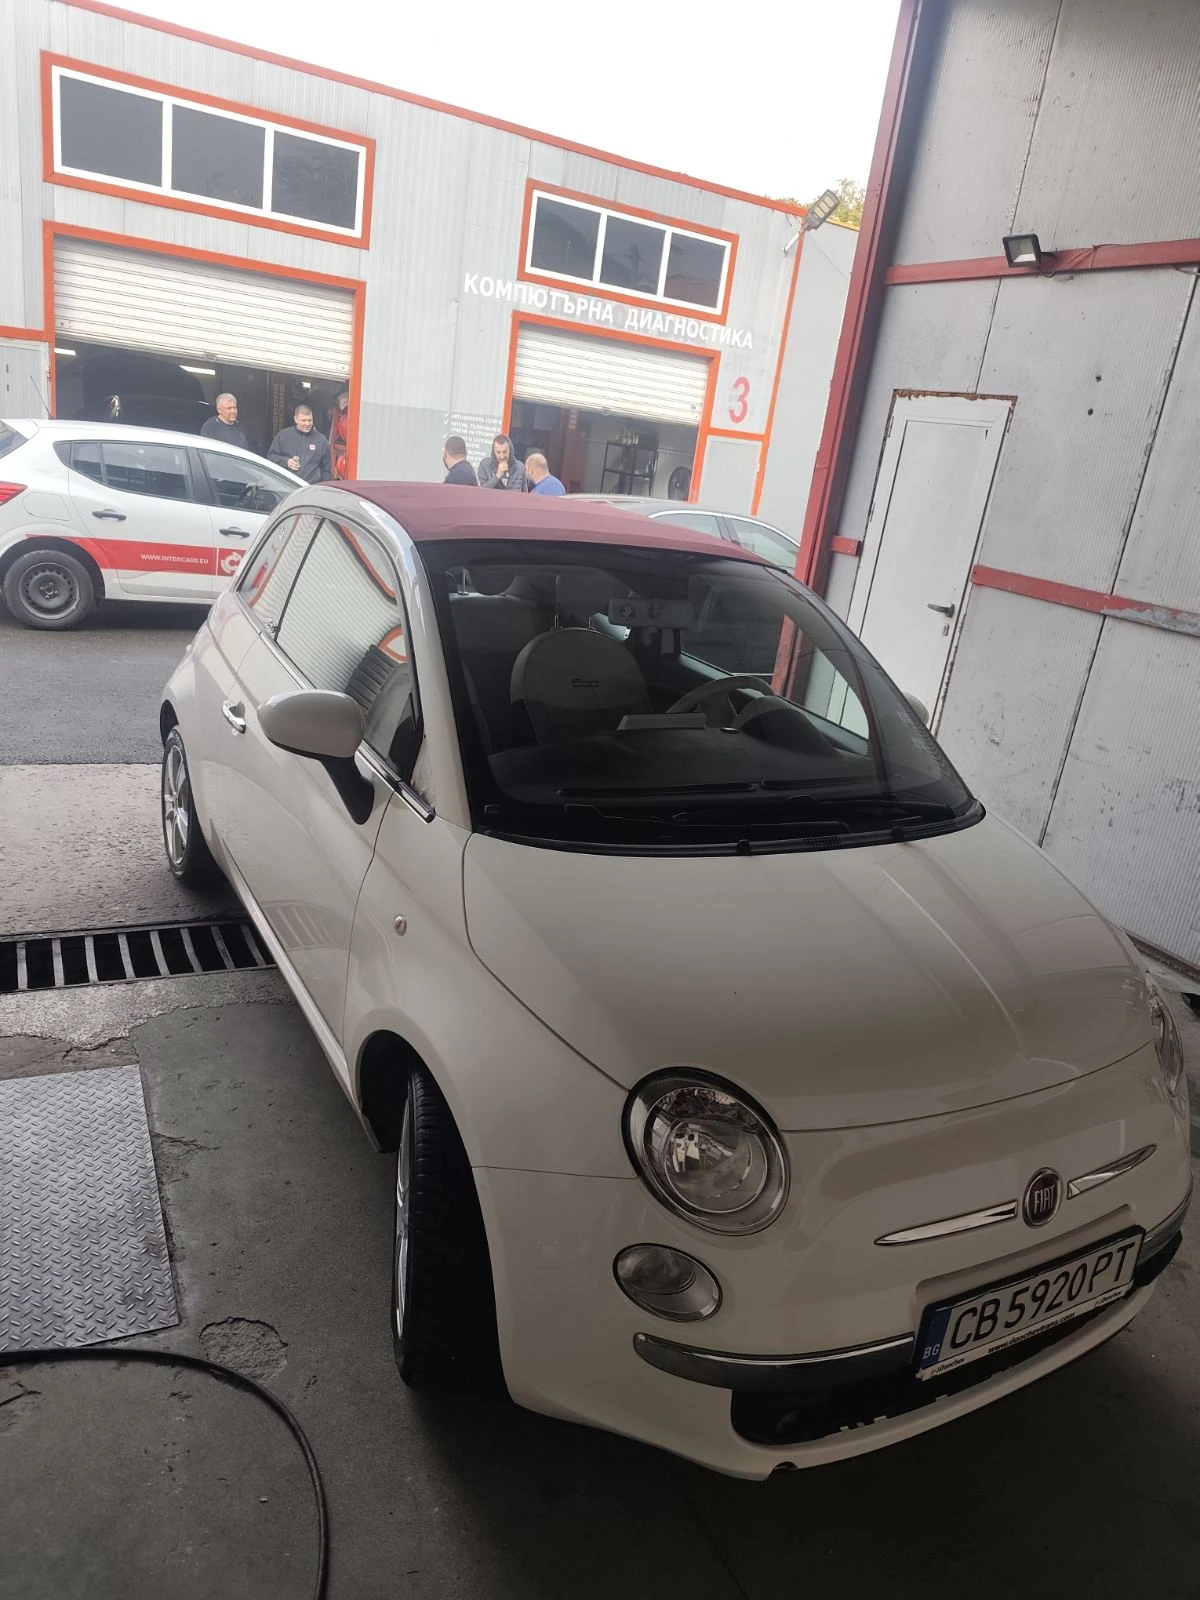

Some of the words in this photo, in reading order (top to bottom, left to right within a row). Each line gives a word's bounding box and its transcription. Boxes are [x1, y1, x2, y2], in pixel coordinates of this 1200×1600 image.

[464, 273, 614, 323] КОМПЮТЪРНА
[625, 308, 753, 349] ДИАГНОСТИКА
[729, 376, 750, 424] 3
[141, 553, 209, 565] WWW.INTERCARS.EU
[1033, 1184, 1056, 1214] FIAT
[923, 1343, 941, 1359] BG
